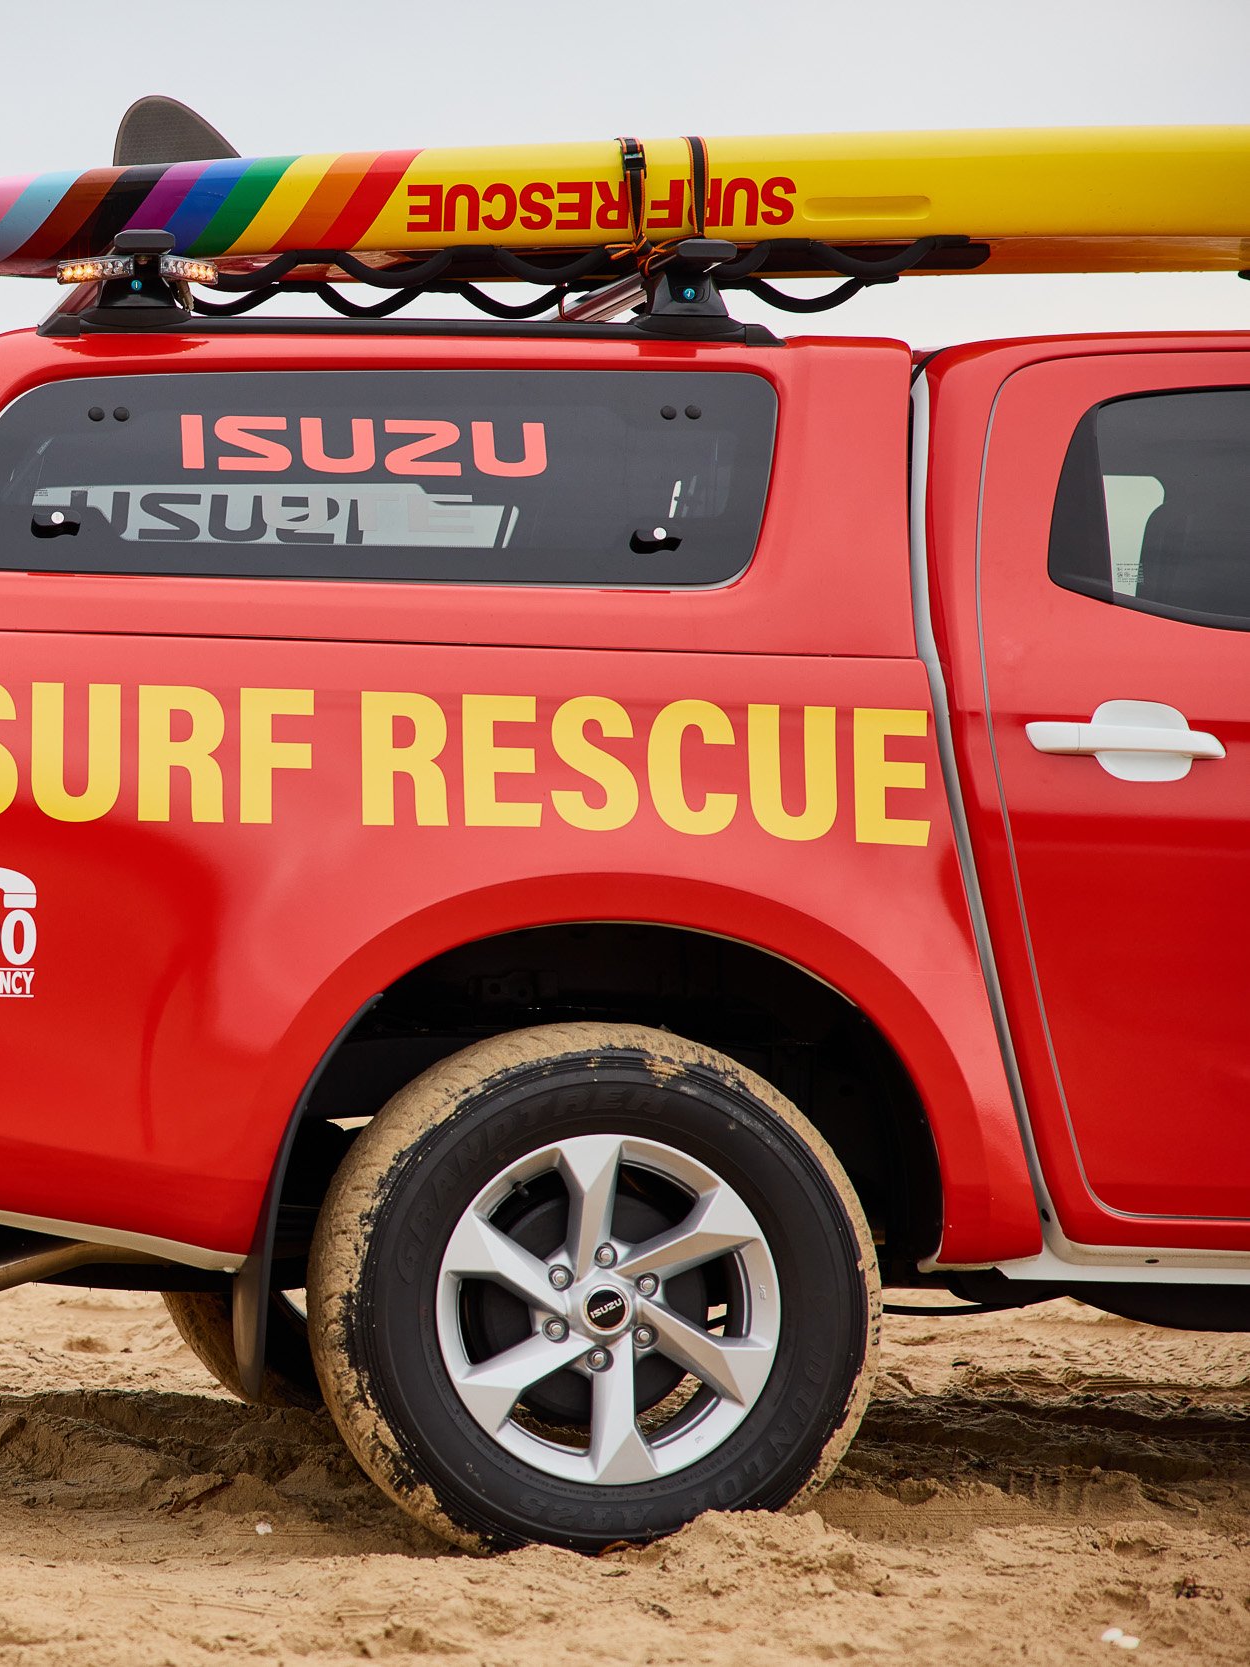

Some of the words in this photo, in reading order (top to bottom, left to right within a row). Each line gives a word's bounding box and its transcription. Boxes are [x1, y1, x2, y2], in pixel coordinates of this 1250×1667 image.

[406, 181, 630, 233] RESCUE
[180, 414, 548, 478] ISUZU
[361, 690, 931, 847] RESCUE
[397, 1086, 669, 1284] GRANDTREK
[590, 1297, 623, 1319] ISUZU
[511, 1490, 655, 1533] AT25
